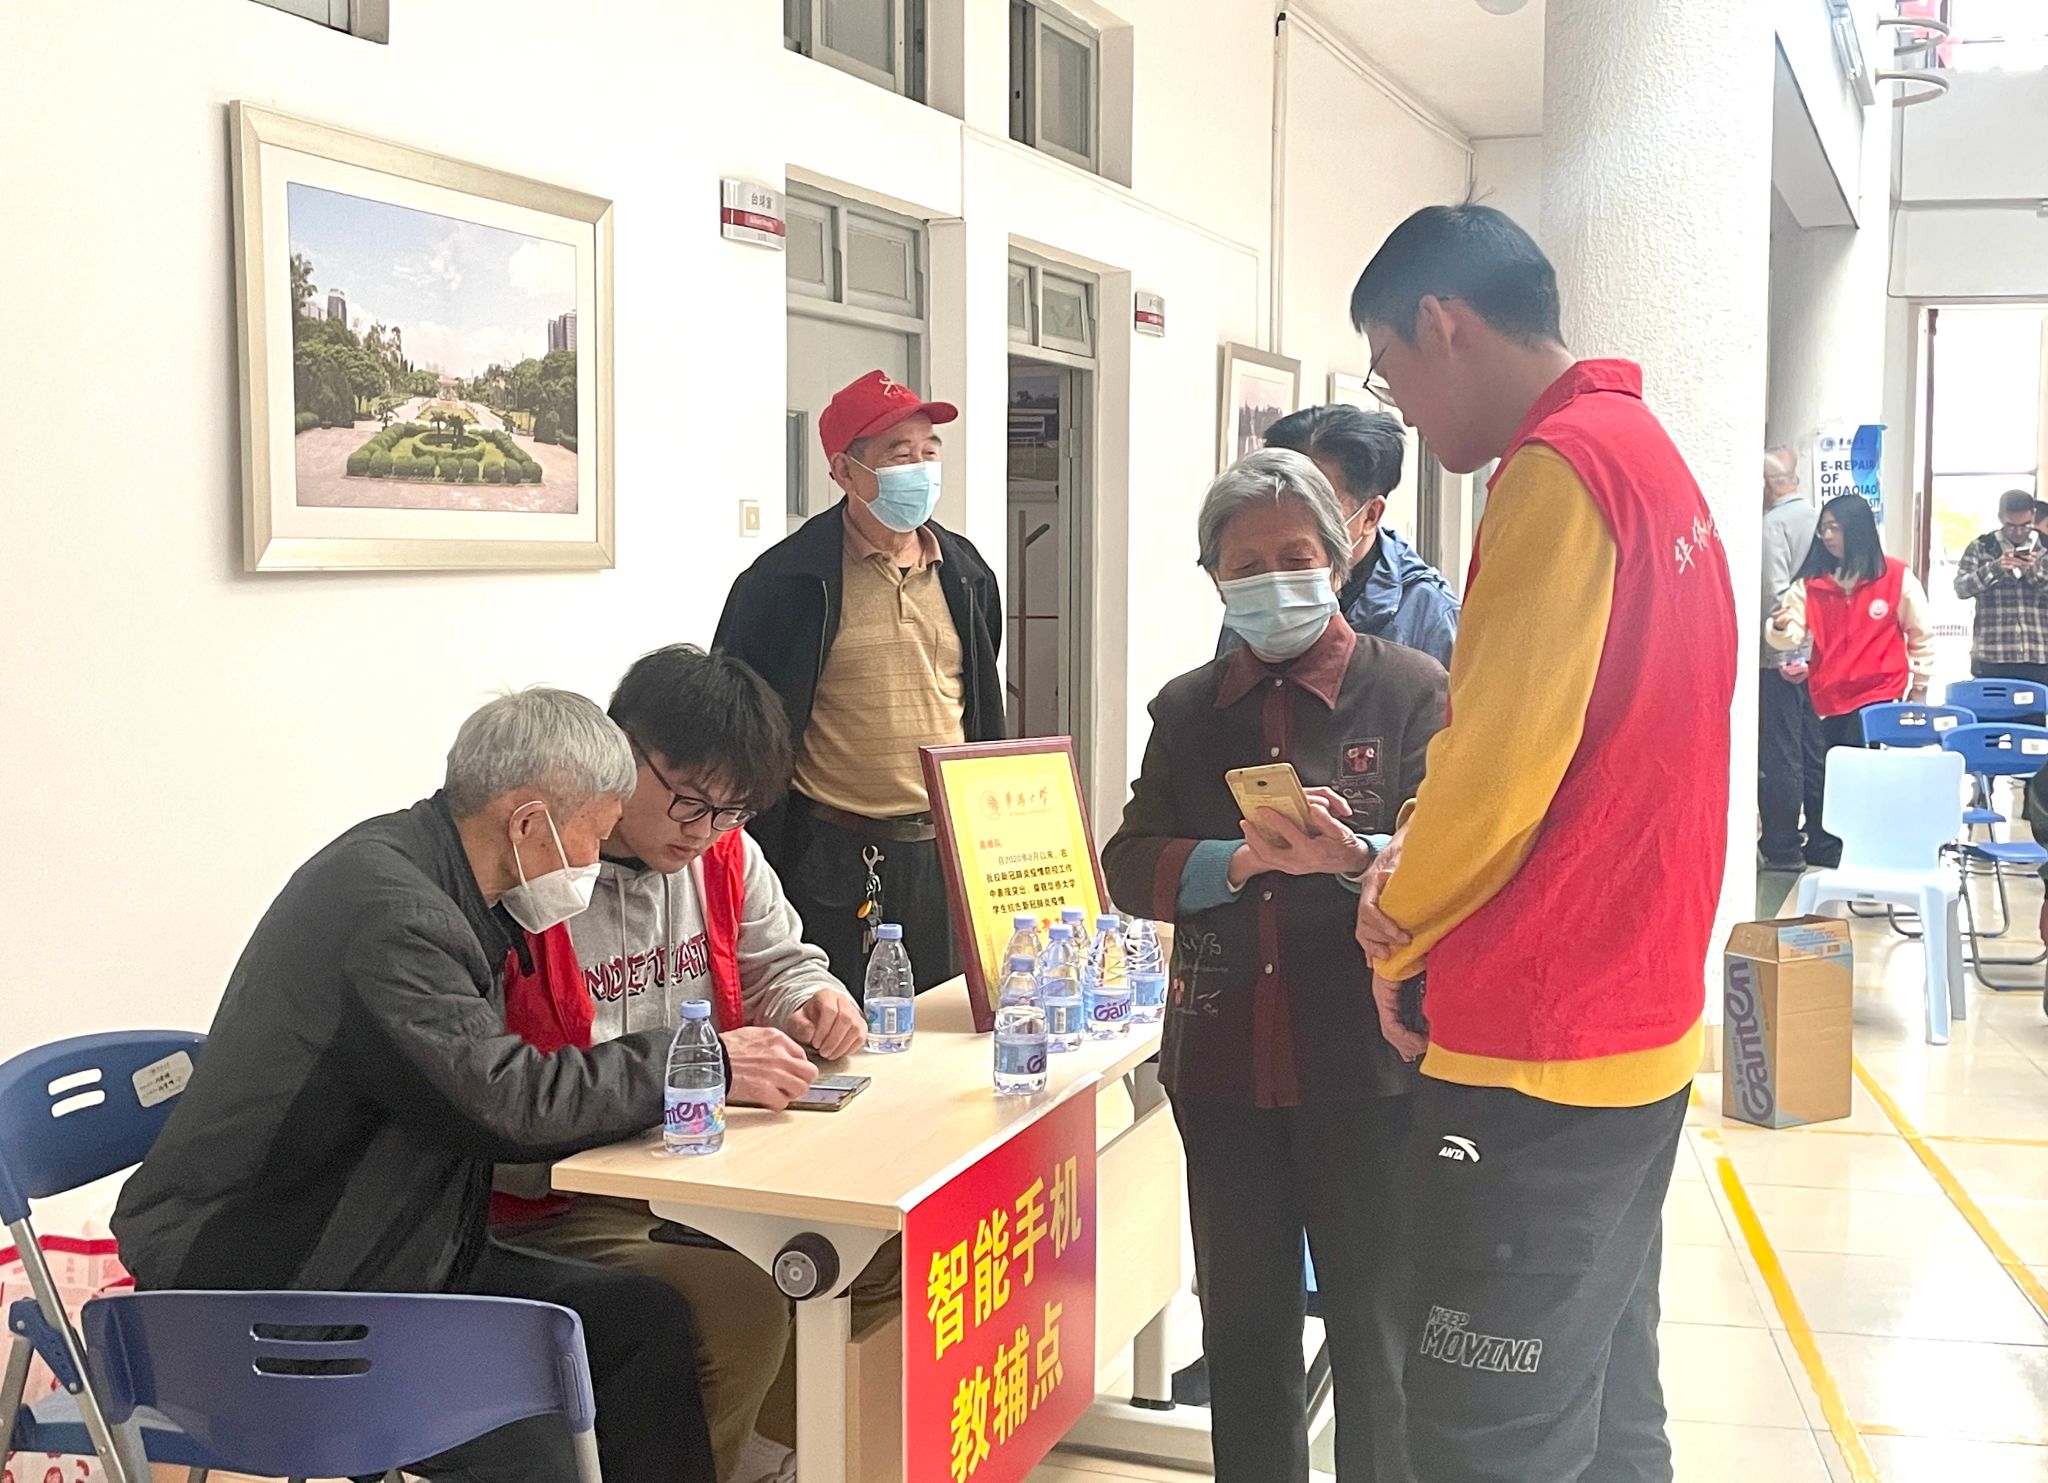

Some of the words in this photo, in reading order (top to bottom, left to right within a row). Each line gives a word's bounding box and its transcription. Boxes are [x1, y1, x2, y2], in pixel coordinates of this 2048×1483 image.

[1820, 459, 1875, 471] E-REPAIR
[1820, 473, 1839, 484] OF
[1726, 962, 1773, 1122] Ganten
[1438, 1146, 1465, 1161] ANTA
[927, 1155, 1082, 1361] 智能手机
[1429, 1305, 1470, 1326] KEEP
[1420, 1322, 1543, 1373] MOVING
[950, 1301, 1064, 1483] 教辅点
